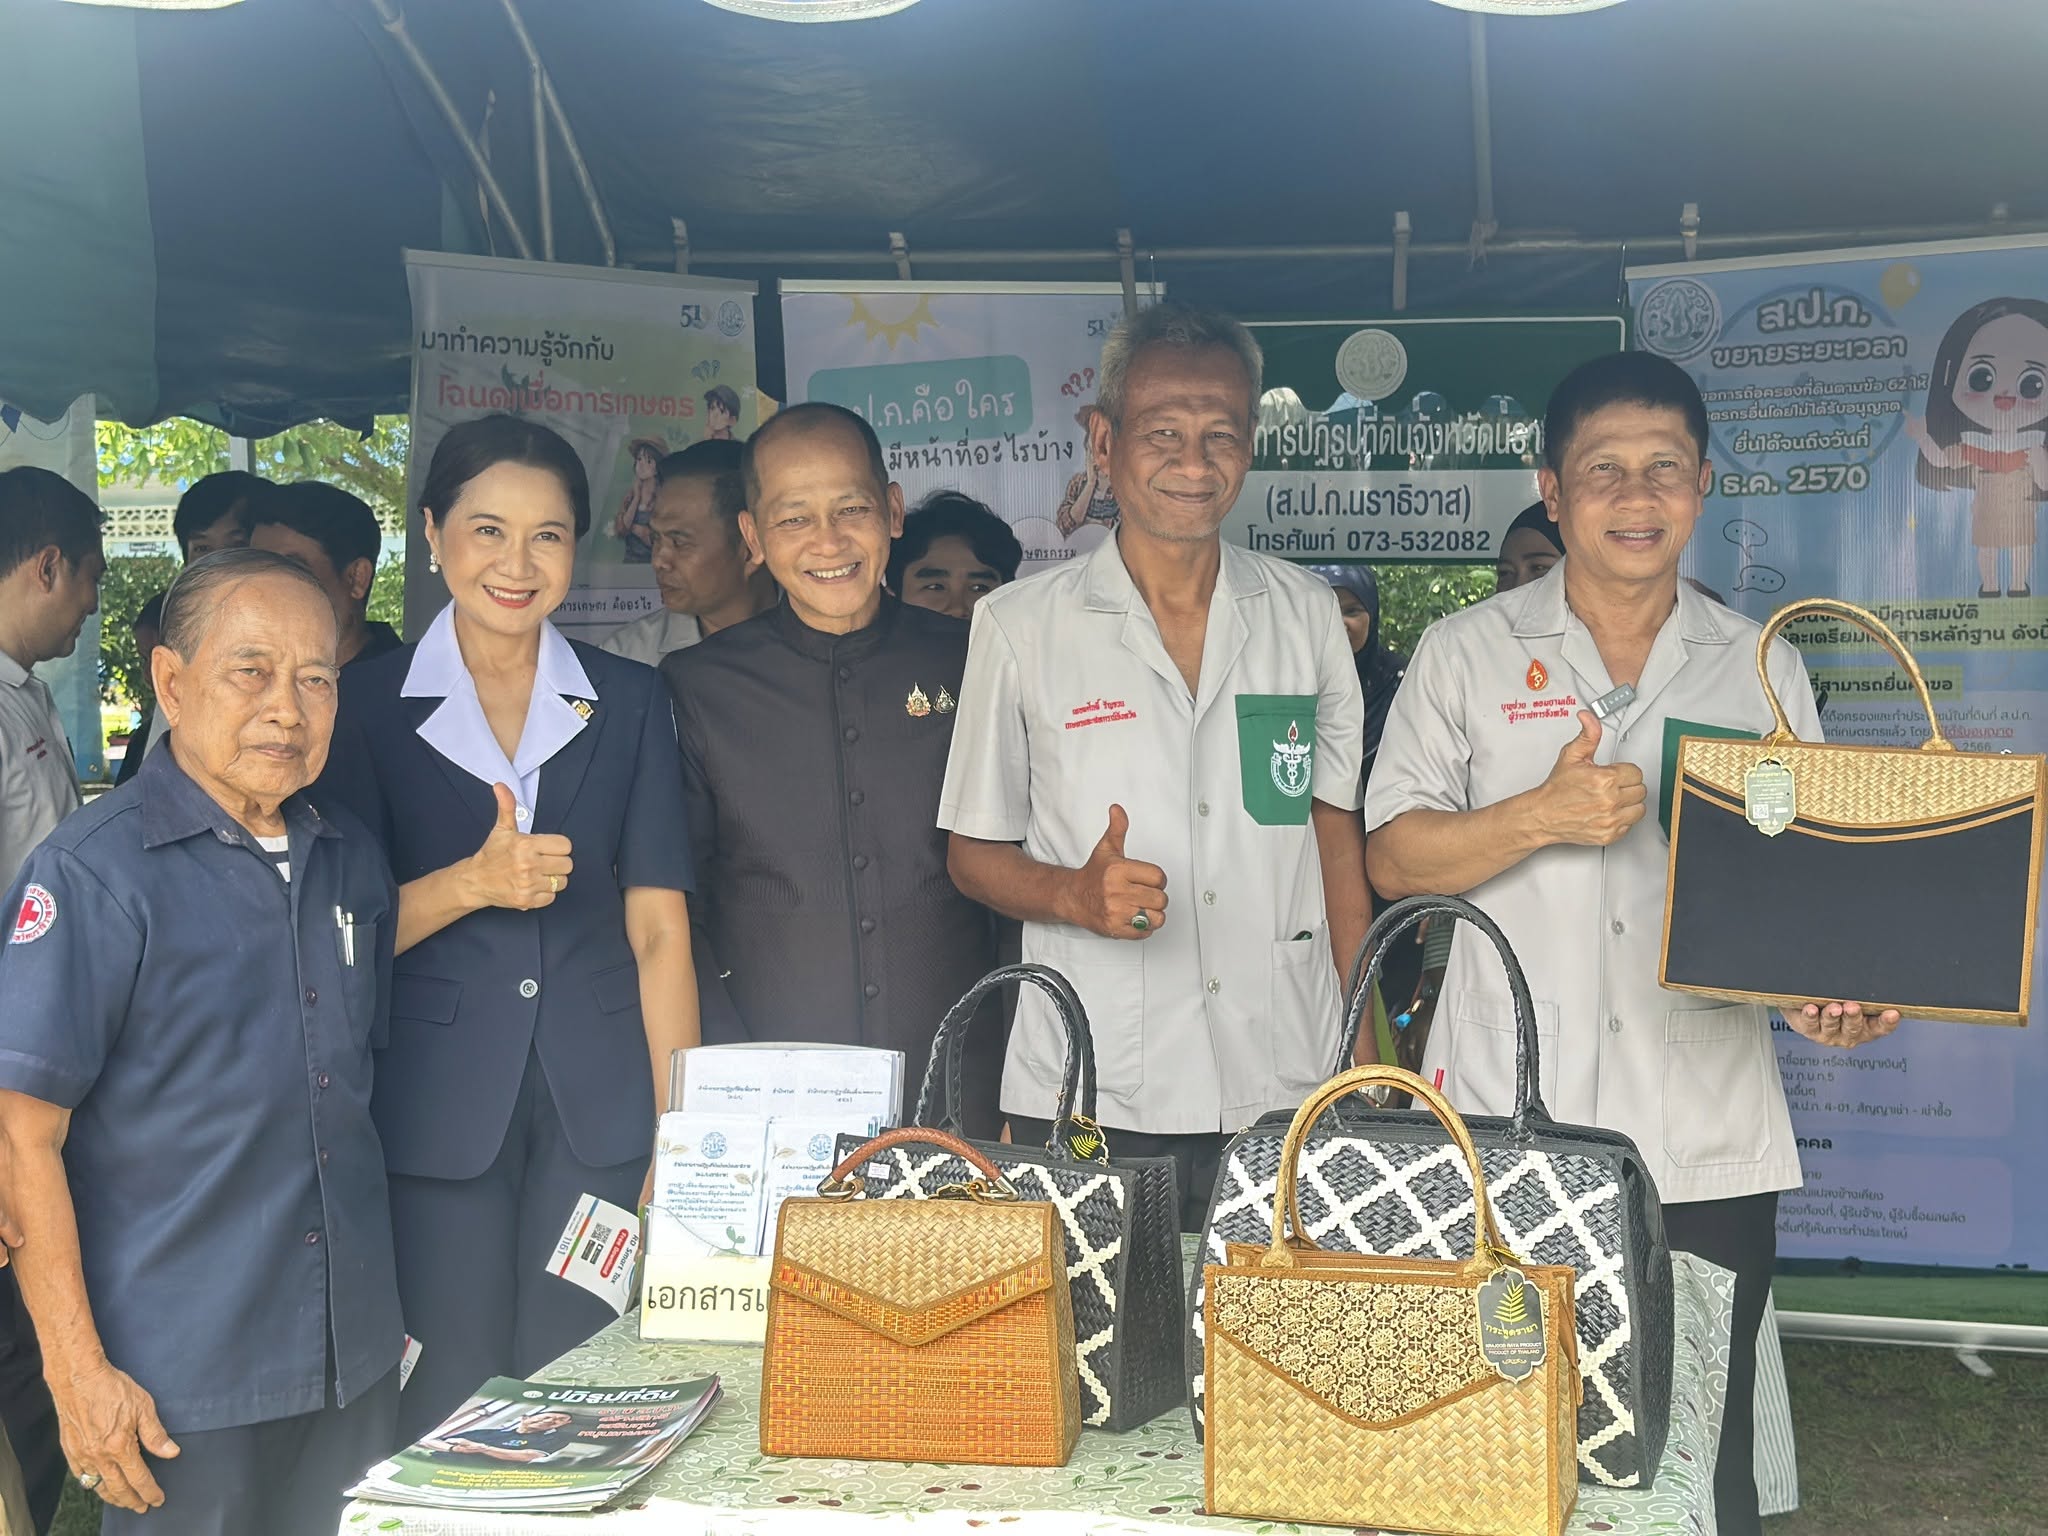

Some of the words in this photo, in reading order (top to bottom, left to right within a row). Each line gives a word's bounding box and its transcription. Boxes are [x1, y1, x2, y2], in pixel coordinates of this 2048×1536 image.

[1759, 290, 1869, 332] ส.ป.ก.
[420, 325, 615, 367] มาทำความรู้จักกับ
[1711, 335, 1908, 369] ขยายระยะเวลา
[438, 370, 695, 419] โฉนดเพื่อการเกษตร
[1706, 398, 1902, 422] ตรกรอื่นโดยไม่ได้รับอนุญาต
[888, 428, 1074, 471] มีหน้าที่อะไรบ้าง
[1254, 410, 1545, 468] การปฏิรูปที่ดินจังหวัดนรา
[1733, 424, 1871, 455] ยื่นได้จนถึงวันที่
[1721, 469, 1780, 497] ธ.ค.
[1787, 464, 1869, 493] 2570
[1265, 484, 1473, 525] (ส.ป.ก.นราธิวาส)
[1247, 524, 1335, 552] โทรศัพท์
[1346, 530, 1492, 553] 073-532082
[557, 1236, 573, 1256] 1161
[617, 1248, 633, 1270] Smart
[648, 1284, 770, 1312] เอกสารเ
